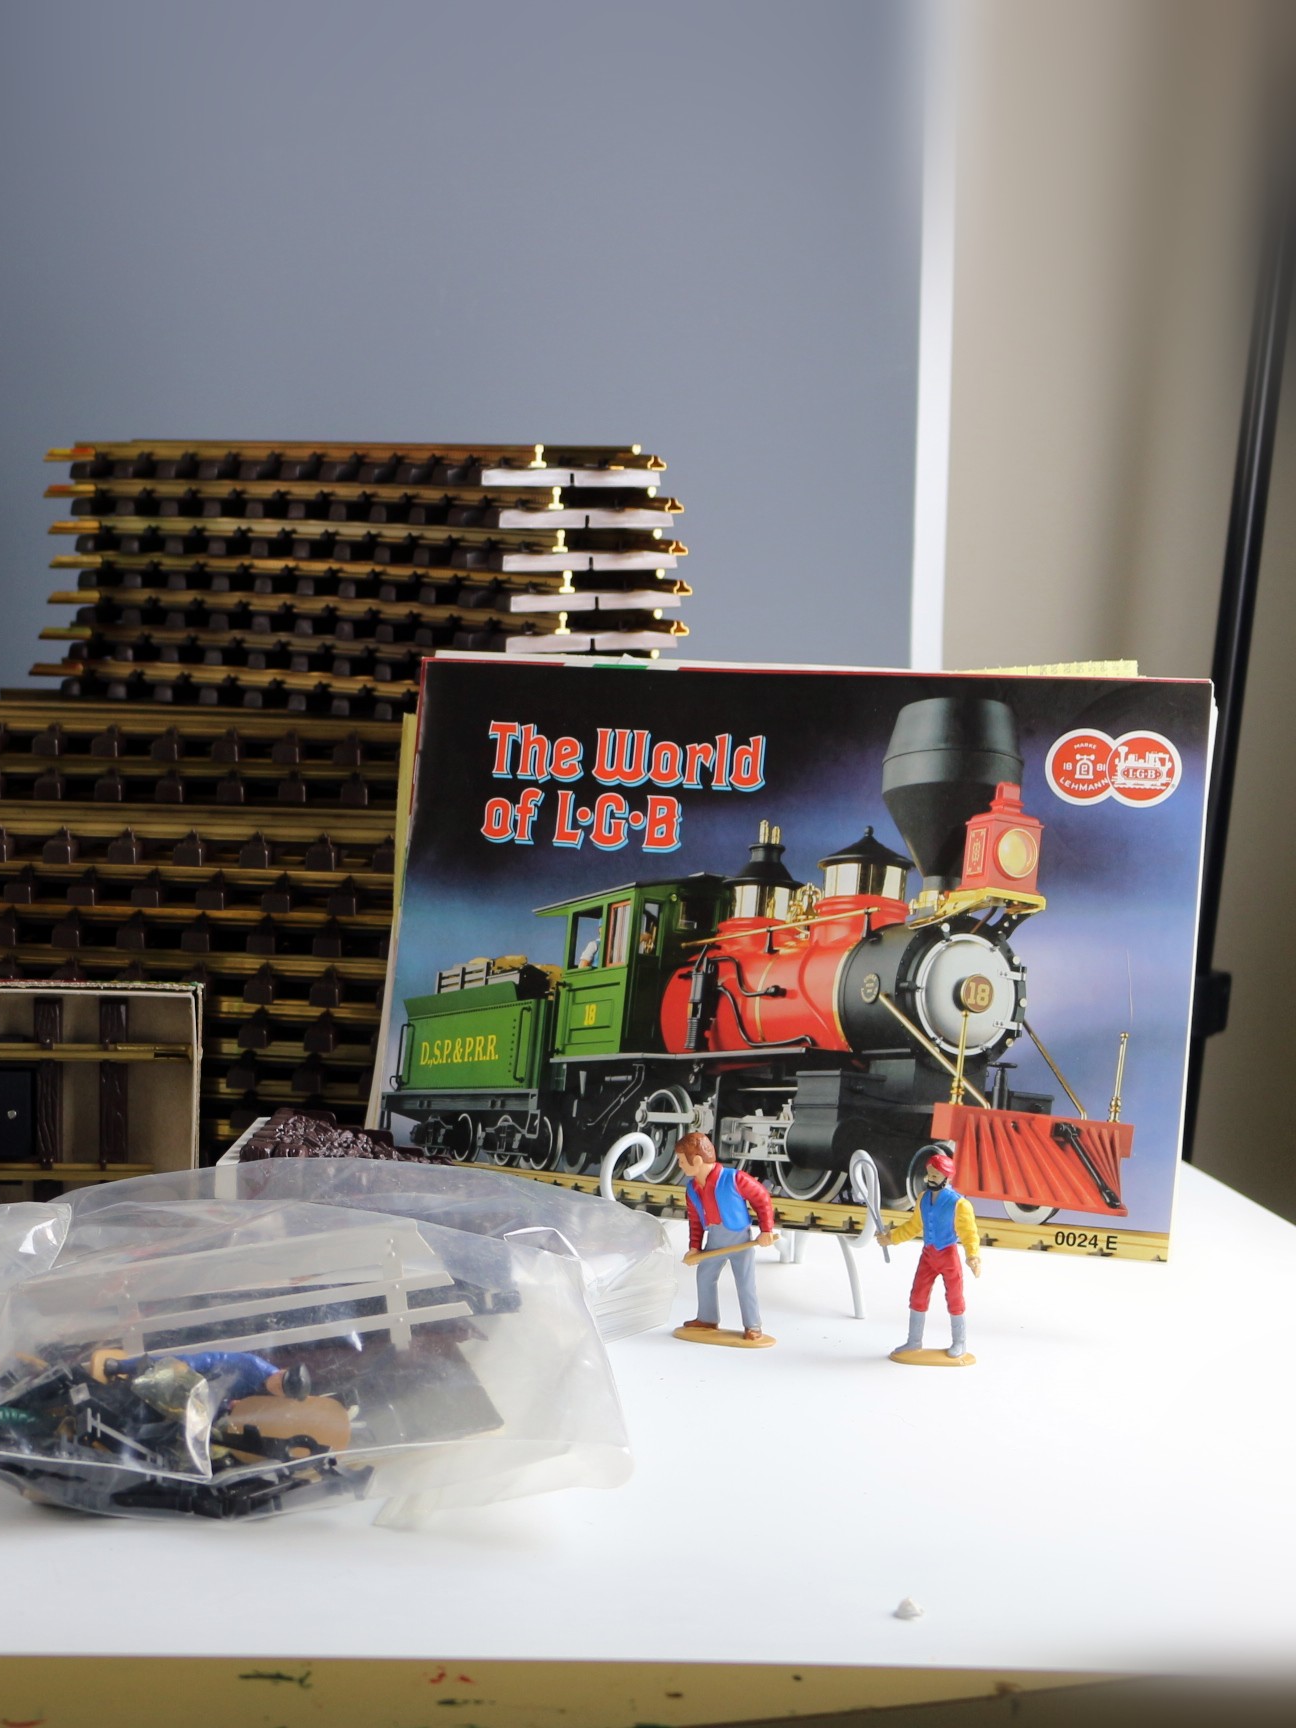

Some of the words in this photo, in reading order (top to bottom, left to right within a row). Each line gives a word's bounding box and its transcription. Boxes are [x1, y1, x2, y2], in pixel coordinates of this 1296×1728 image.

[489, 720, 584, 783] The
[591, 727, 766, 792] World
[1073, 742, 1097, 750] MARKE
[1059, 776, 1109, 791] LEHMANN
[480, 787, 545, 845] of
[966, 981, 991, 1007] 18
[583, 1004, 598, 1026] 18
[1054, 1231, 1098, 1249] 0024
[1105, 1235, 1118, 1250] E
